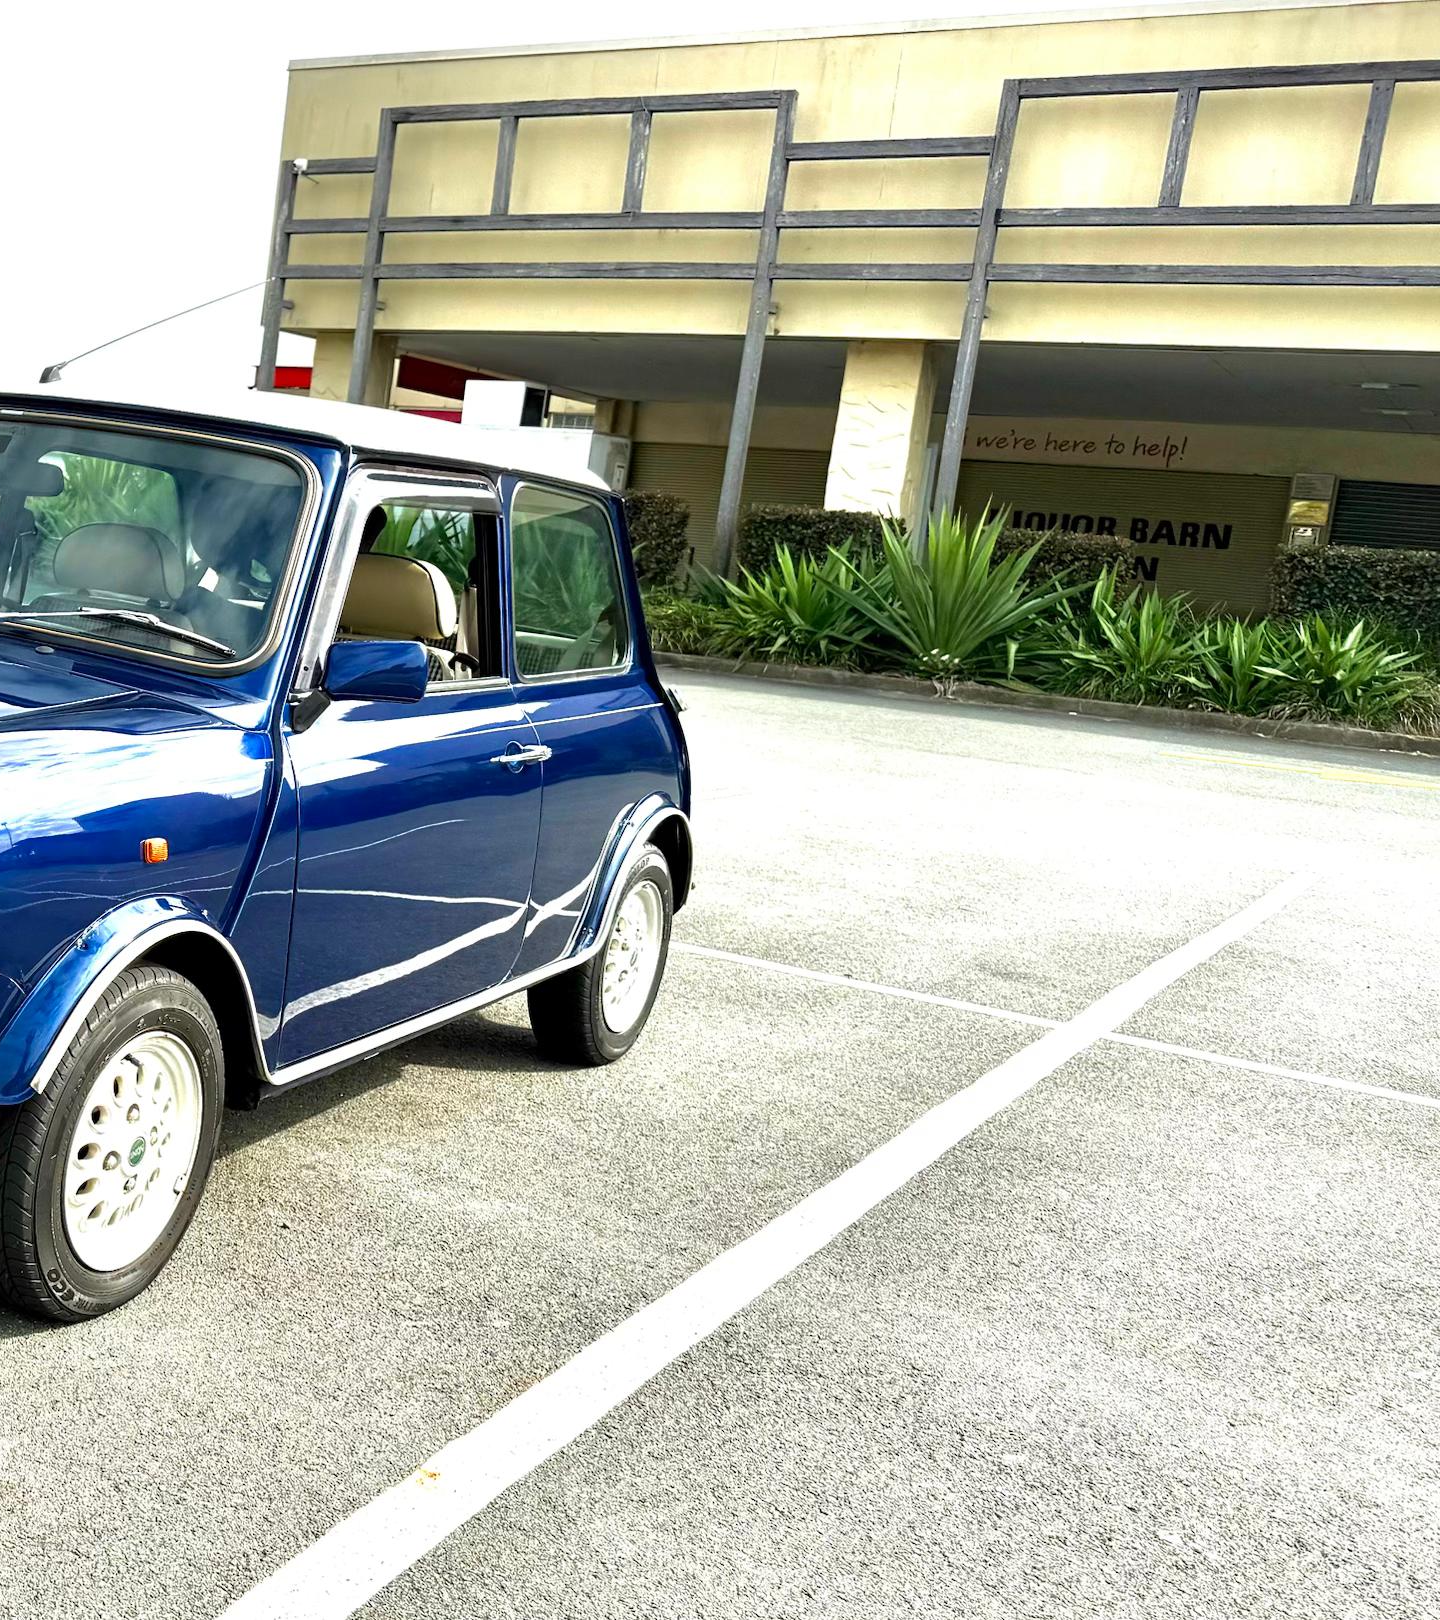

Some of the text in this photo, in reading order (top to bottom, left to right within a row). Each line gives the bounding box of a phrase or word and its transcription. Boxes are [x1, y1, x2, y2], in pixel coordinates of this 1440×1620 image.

[976, 429, 1037, 450] we're
[1044, 432, 1097, 454] here
[1104, 433, 1125, 455] to
[1131, 435, 1188, 468] help!
[1129, 517, 1233, 550] BARN
